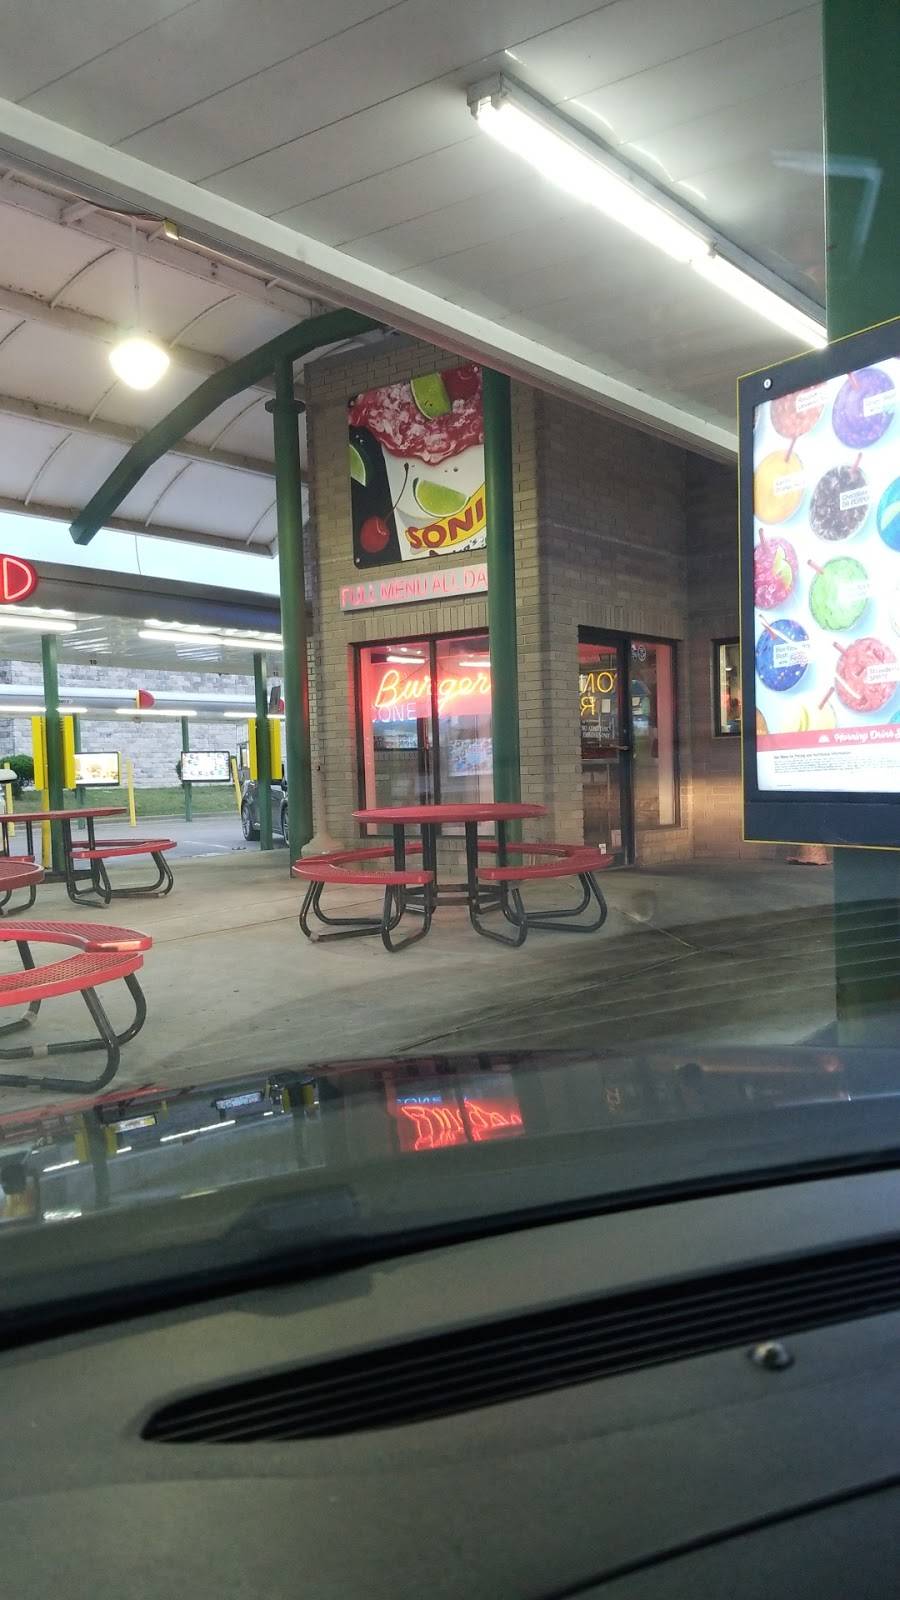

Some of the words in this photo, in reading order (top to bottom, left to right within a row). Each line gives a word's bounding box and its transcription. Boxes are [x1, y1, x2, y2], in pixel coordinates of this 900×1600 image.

[405, 497, 484, 549] SONI
[380, 578, 427, 600] MENU
[432, 573, 460, 593] ALL
[463, 568, 488, 589] DA
[371, 702, 417, 723] ONE
